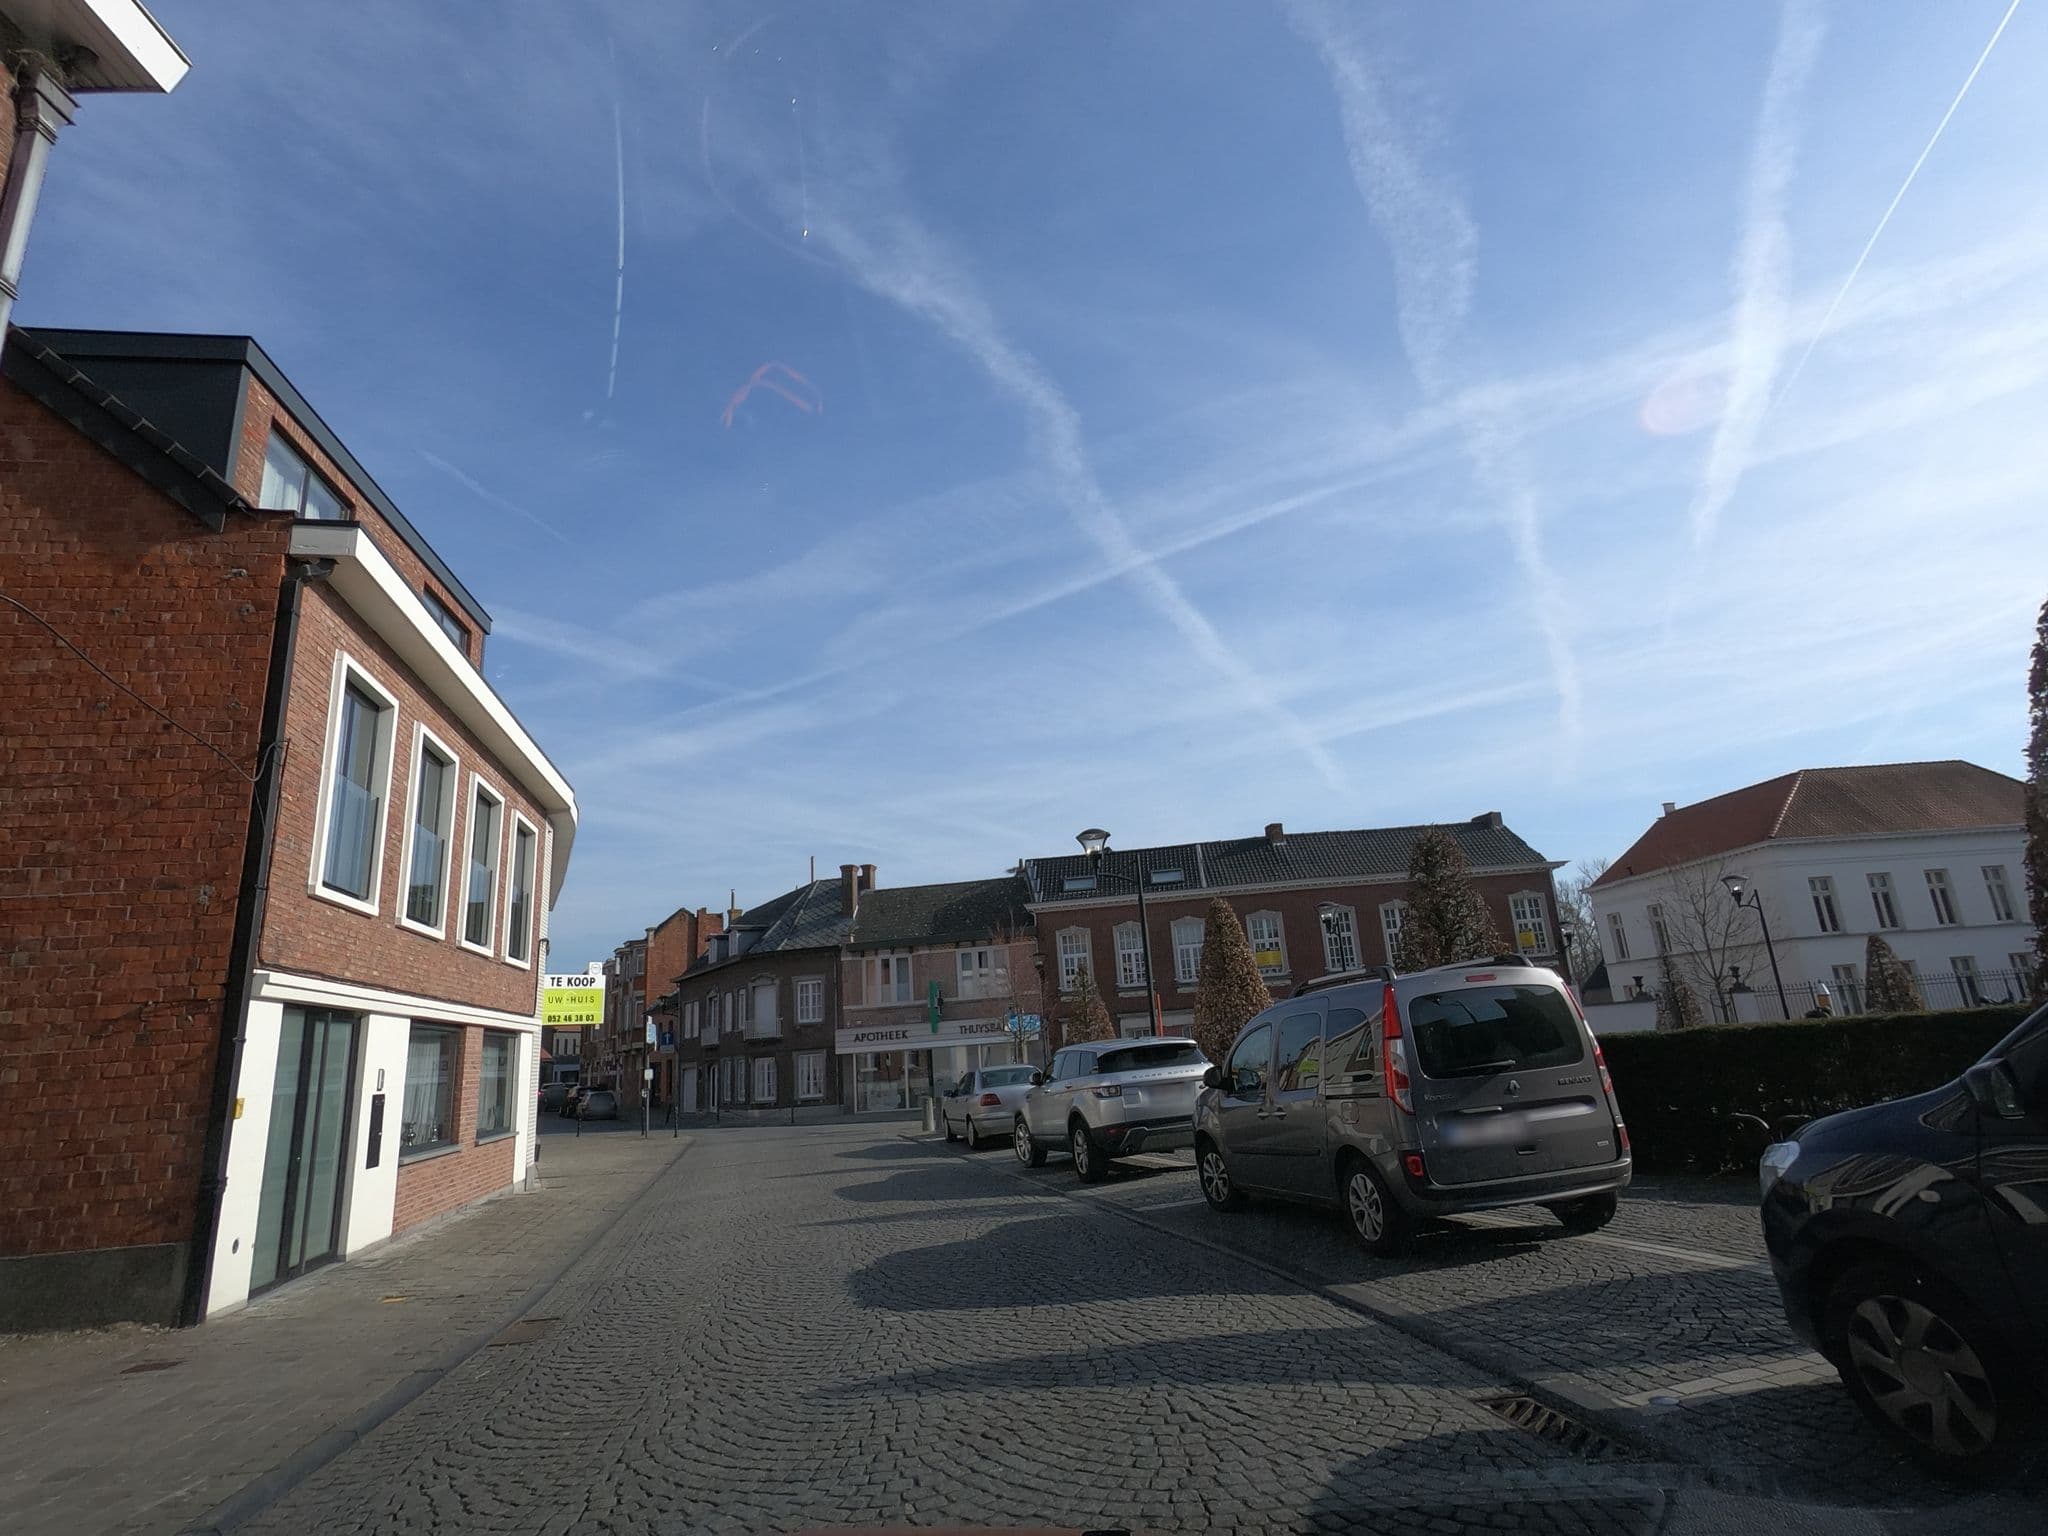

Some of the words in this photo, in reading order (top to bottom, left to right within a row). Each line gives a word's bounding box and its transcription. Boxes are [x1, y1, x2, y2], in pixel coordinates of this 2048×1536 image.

[550, 977, 562, 987] TE
[567, 977, 596, 987] KOOP
[854, 1029, 909, 1043] APOTHEEK
